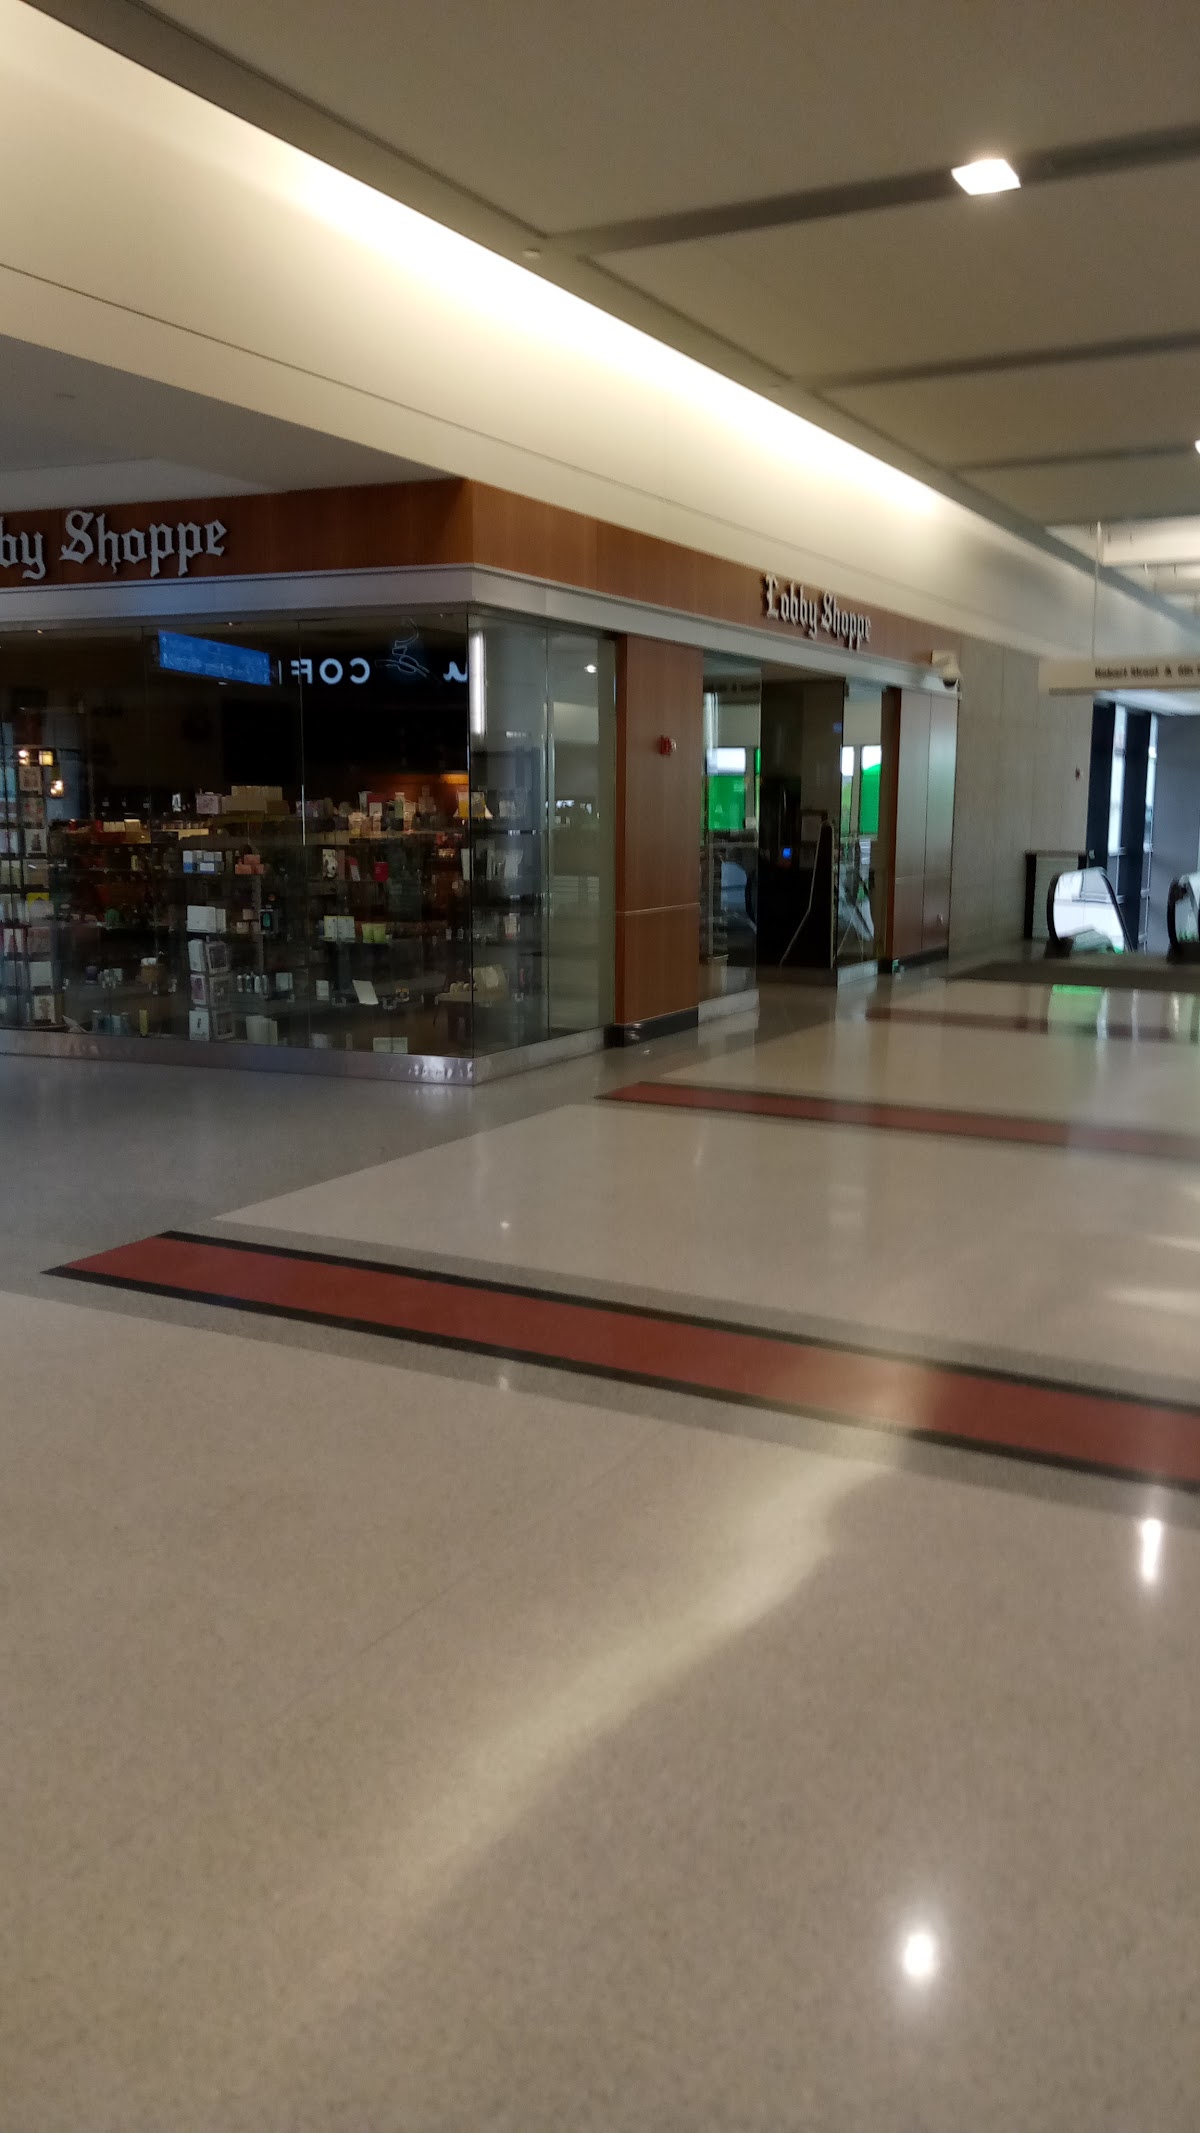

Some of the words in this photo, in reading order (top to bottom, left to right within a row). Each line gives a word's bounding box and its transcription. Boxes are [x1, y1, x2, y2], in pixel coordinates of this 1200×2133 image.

[59, 510, 227, 577] Shoppe
[765, 573, 817, 640] Lobby
[821, 590, 871, 652] Shoppe
